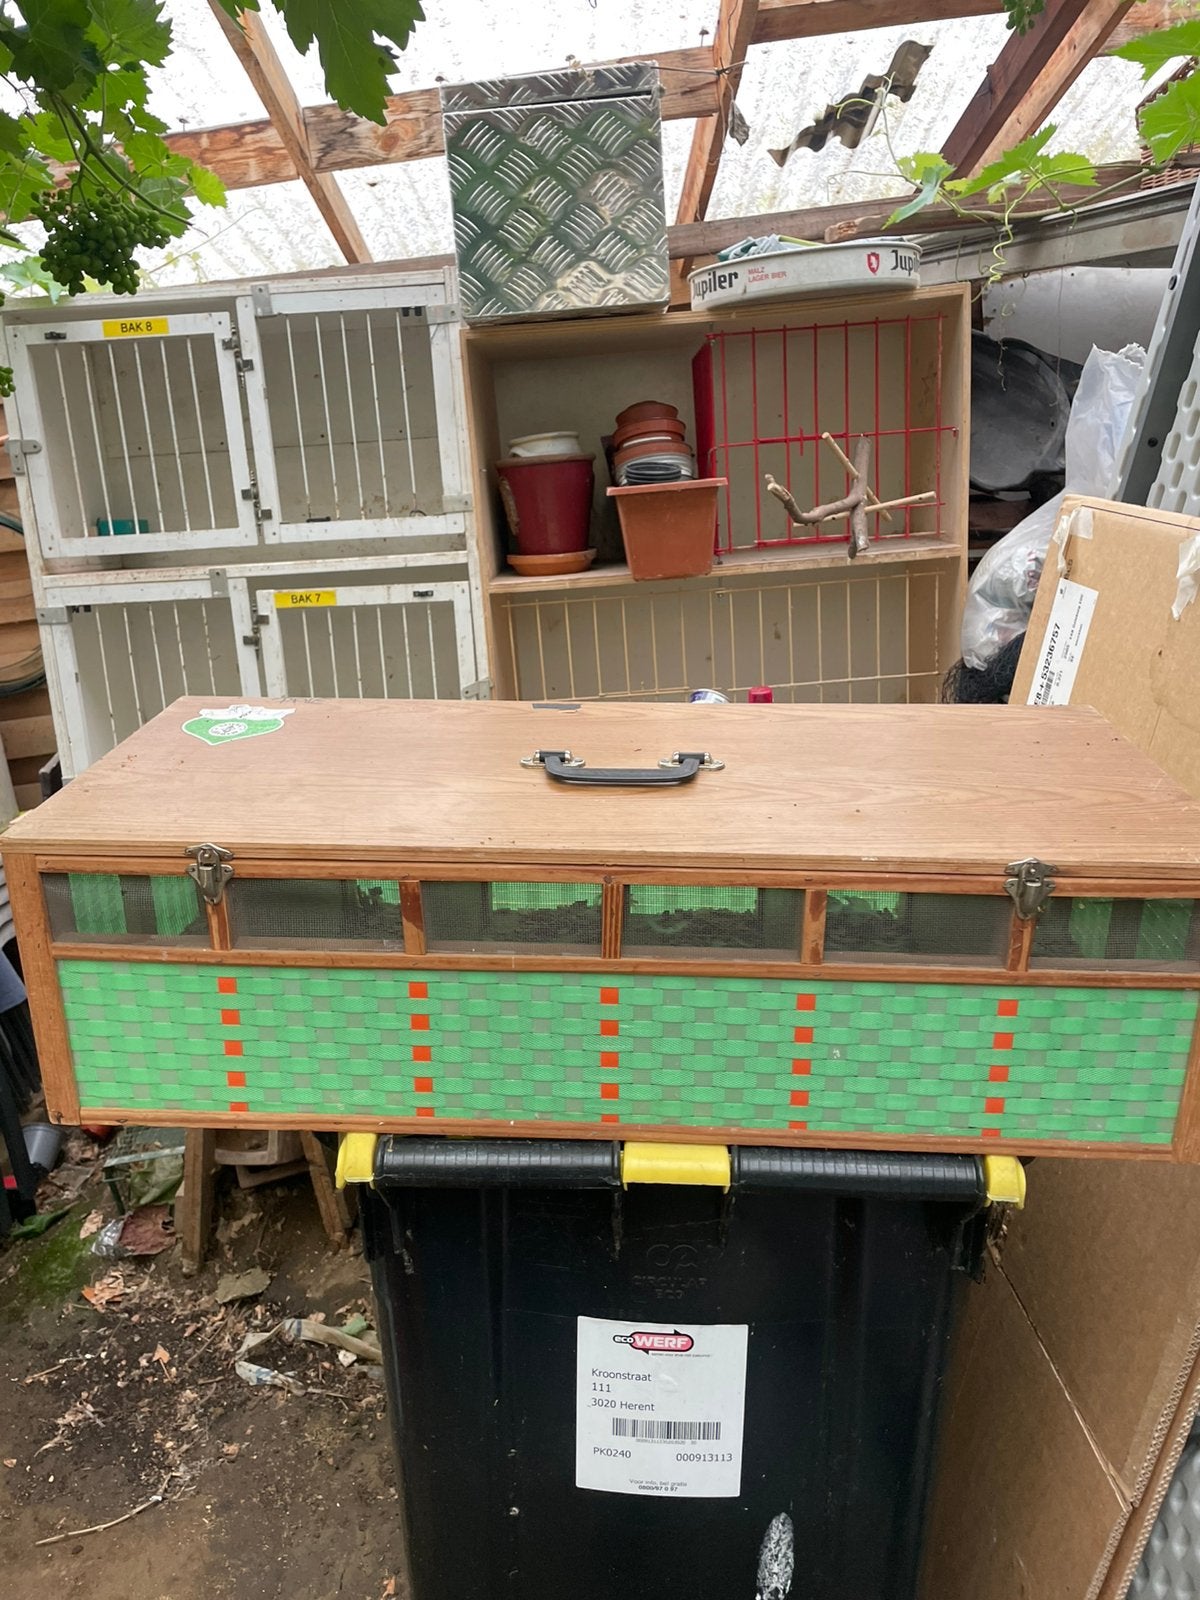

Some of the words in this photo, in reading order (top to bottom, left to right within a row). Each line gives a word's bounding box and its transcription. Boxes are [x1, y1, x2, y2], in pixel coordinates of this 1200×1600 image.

[748, 273, 770, 283] LAGER
[771, 271, 787, 280] BIER
[120, 322, 144, 333] BAK
[145, 321, 153, 332] 8
[290, 594, 312, 604] BAK
[314, 593, 321, 603] 7
[1041, 623, 1061, 681] 53236757
[591, 1368, 652, 1382] Kroonstraat
[592, 1382, 612, 1393] 111
[591, 1398, 617, 1409] 3020
[620, 1401, 655, 1411] Herent
[593, 1447, 632, 1459] PK0240
[676, 1453, 733, 1462] 000913113
